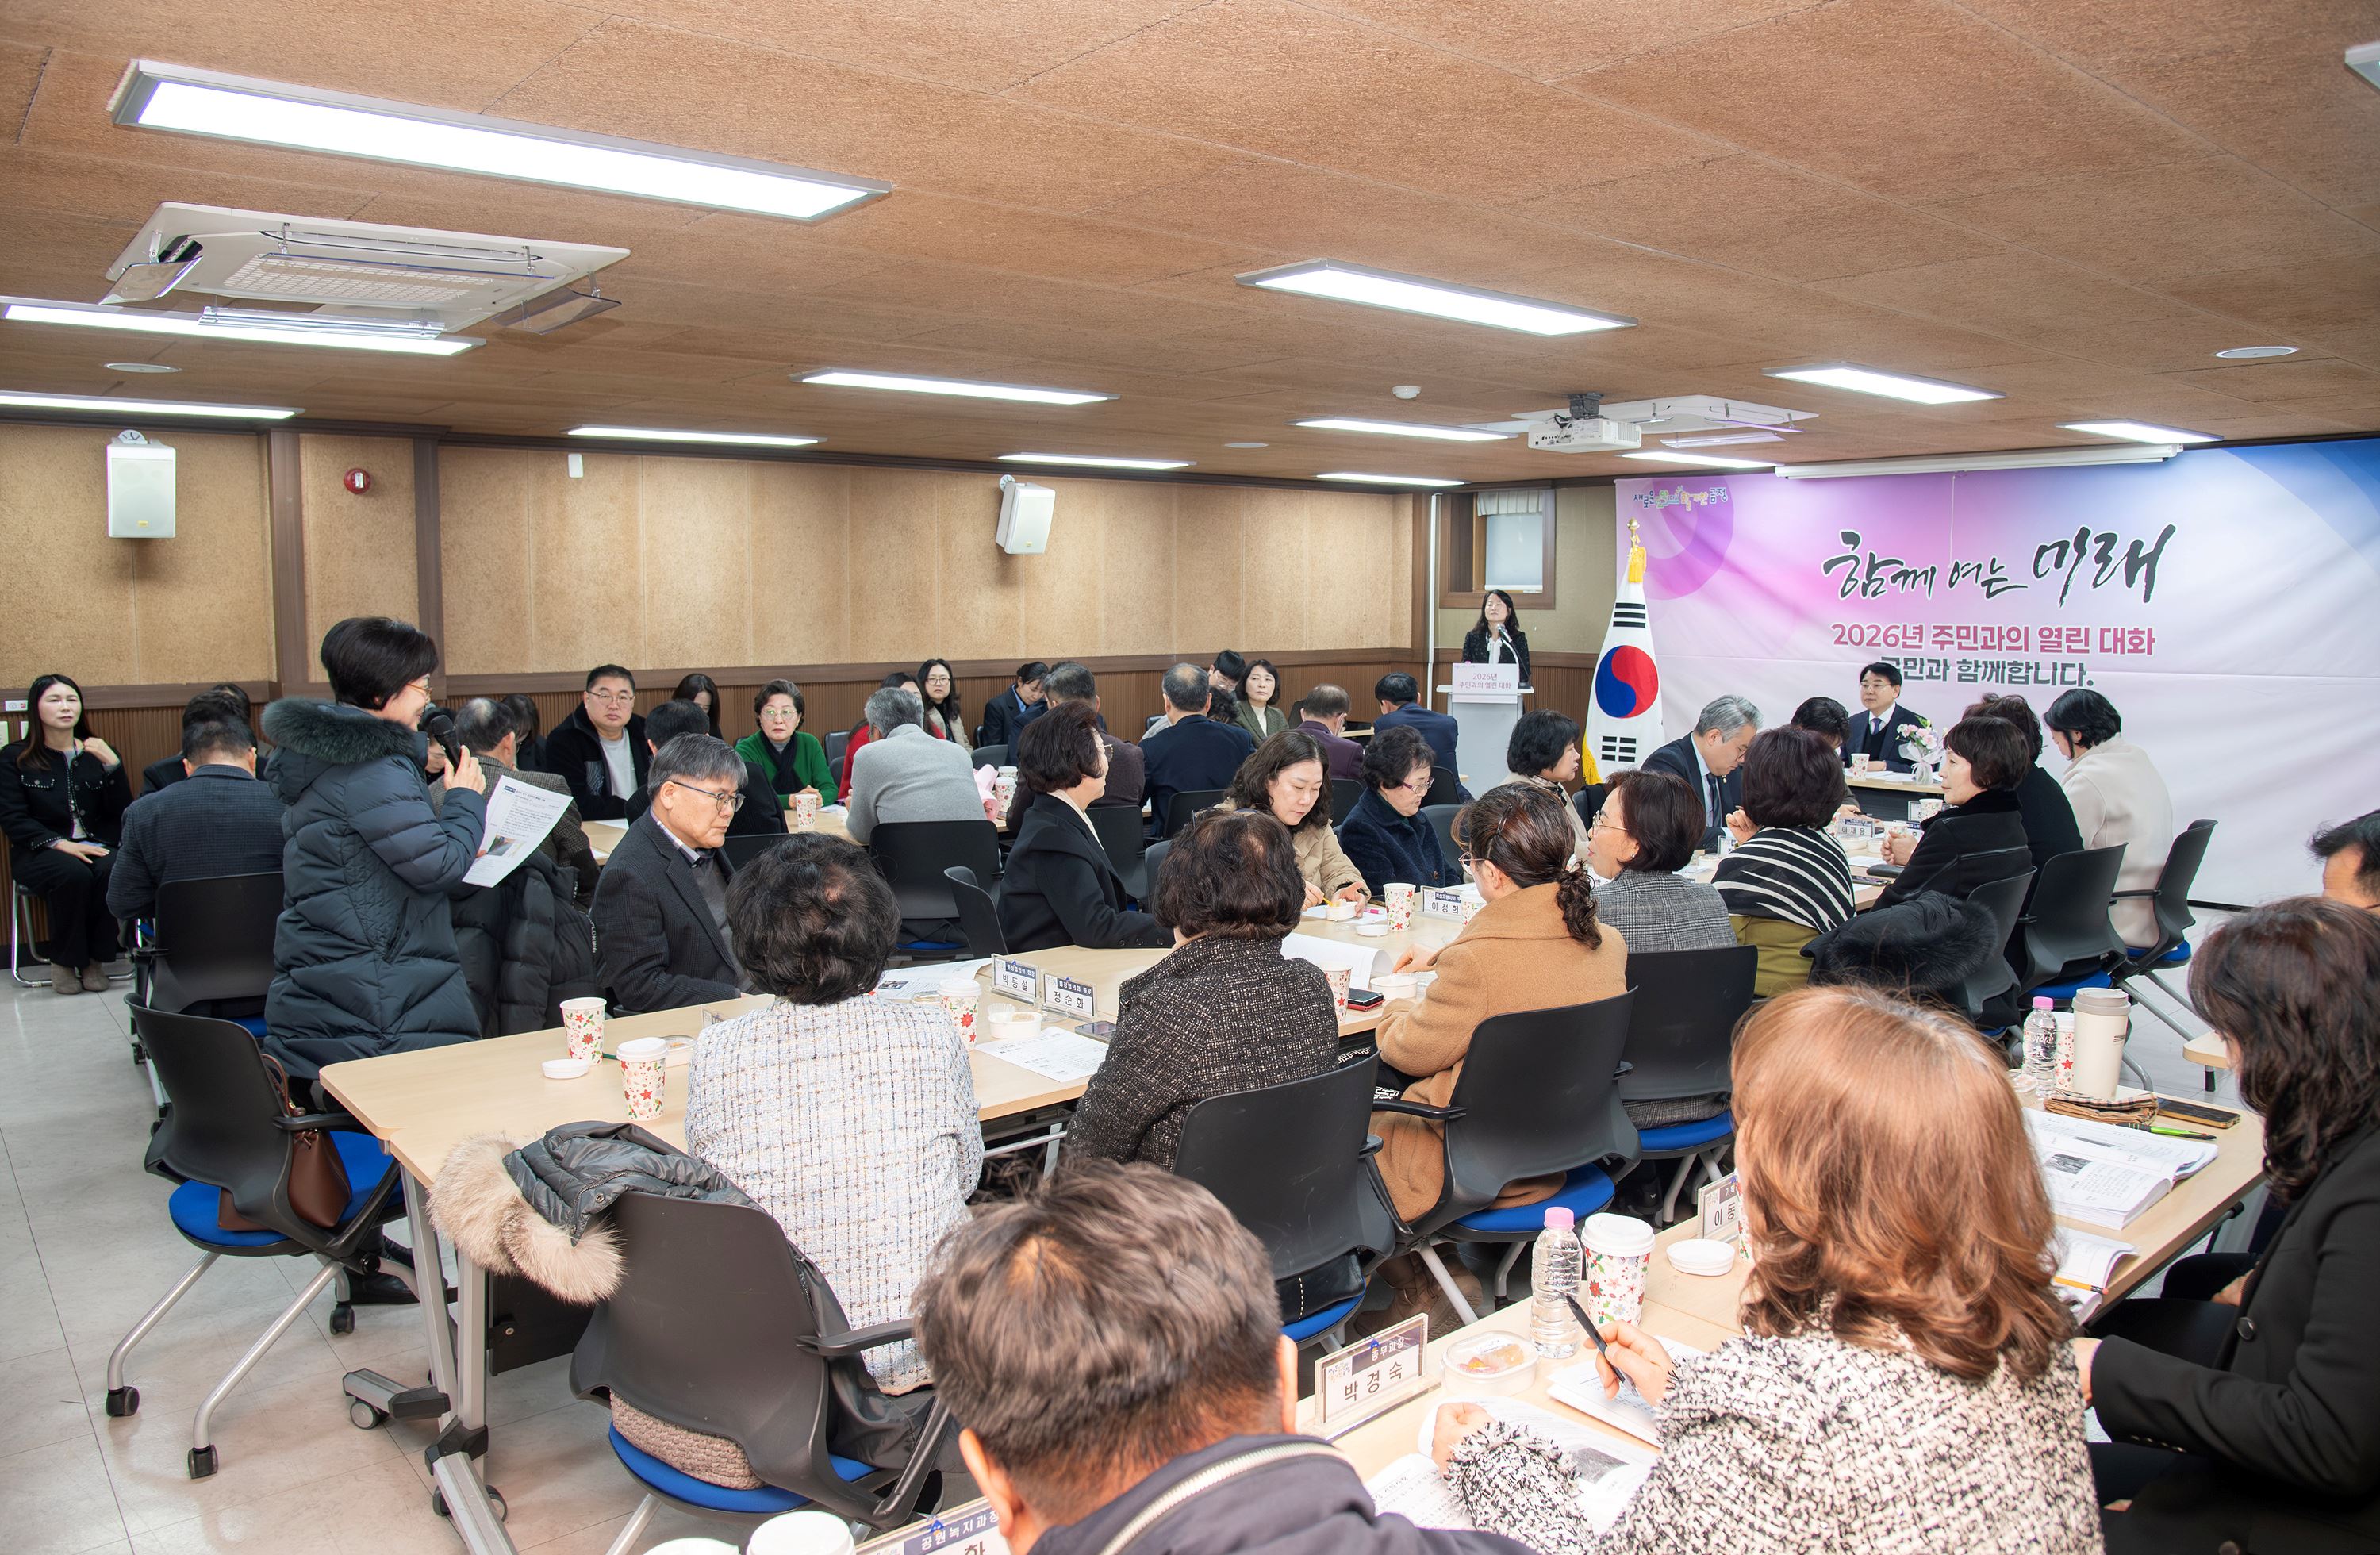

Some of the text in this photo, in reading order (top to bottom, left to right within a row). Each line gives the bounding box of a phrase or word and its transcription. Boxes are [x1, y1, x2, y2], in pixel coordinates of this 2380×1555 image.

[1824, 523, 2177, 609] 함께 여는 미래
[1831, 622, 2156, 656] 2026년 주민과의 열린 대화
[1956, 658, 2095, 688] 함께합니다.
[1002, 973, 1029, 993] 박동설
[1054, 990, 1084, 1010] 정순화
[1345, 1361, 1403, 1402] 박경숙
